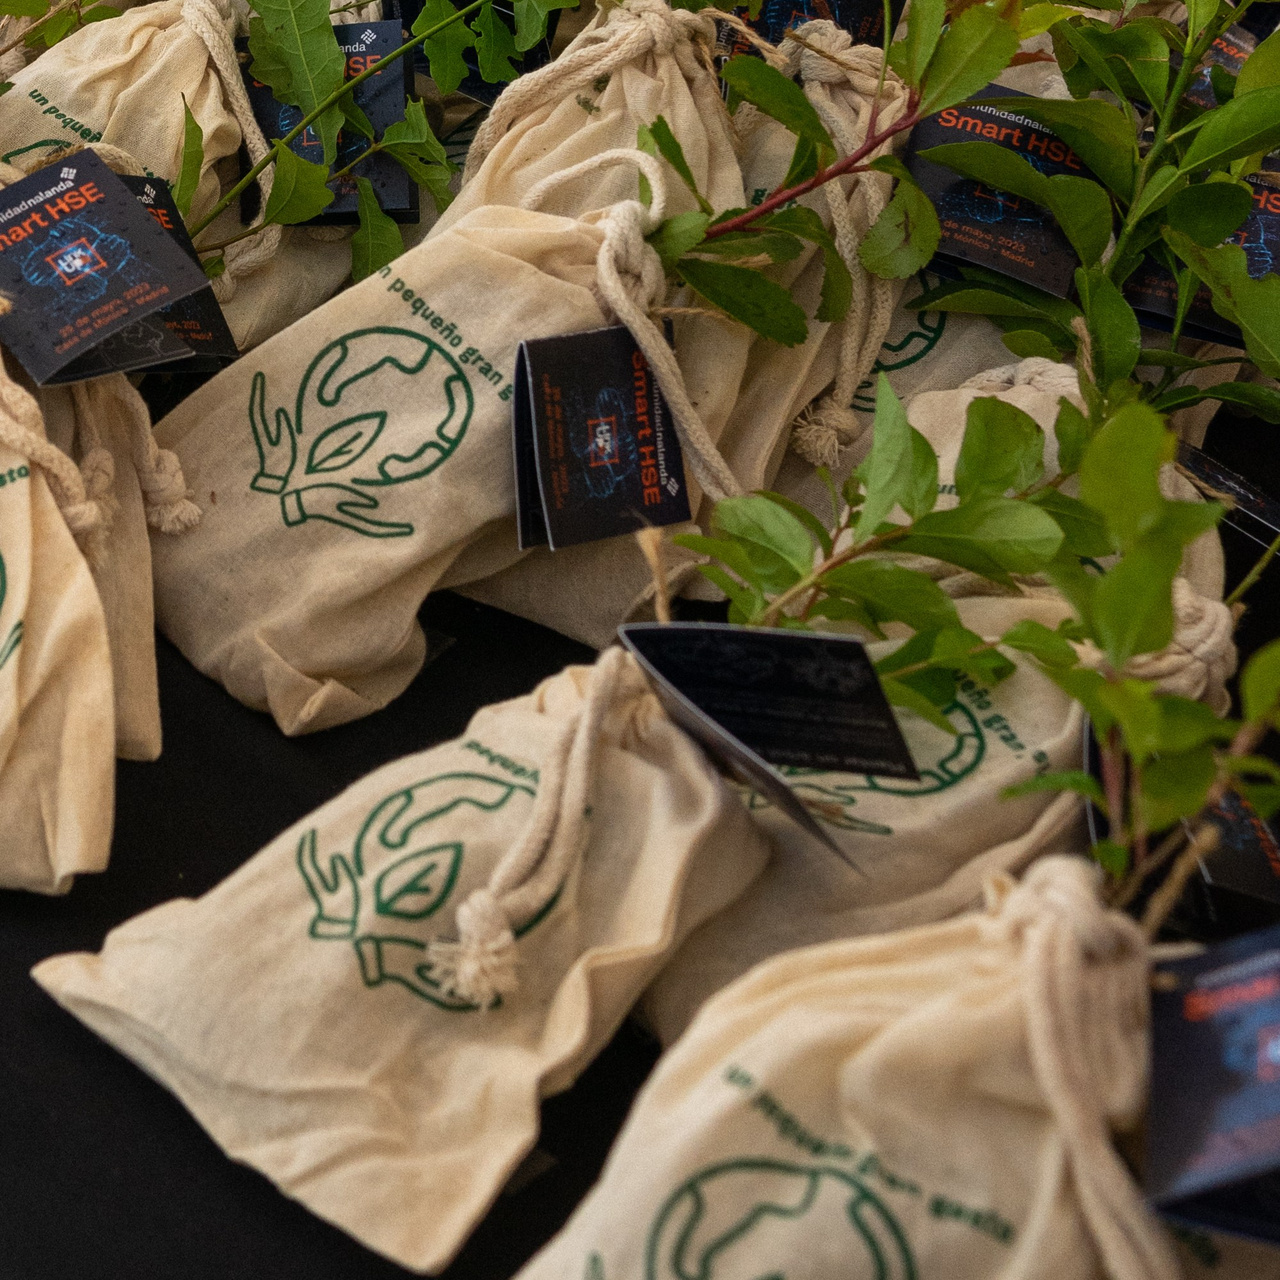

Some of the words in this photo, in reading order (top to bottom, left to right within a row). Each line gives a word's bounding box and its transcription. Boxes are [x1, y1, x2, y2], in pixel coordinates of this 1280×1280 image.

[28, 88, 50, 107] un
[937, 107, 1024, 148] Smart
[1027, 133, 1082, 171] HSE
[45, 180, 107, 223] HSE
[998, 234, 1027, 253] 2023
[386, 277, 463, 348] pequeño
[458, 346, 504, 386] gran
[632, 349, 654, 441] Smart
[638, 445, 663, 507] HSE
